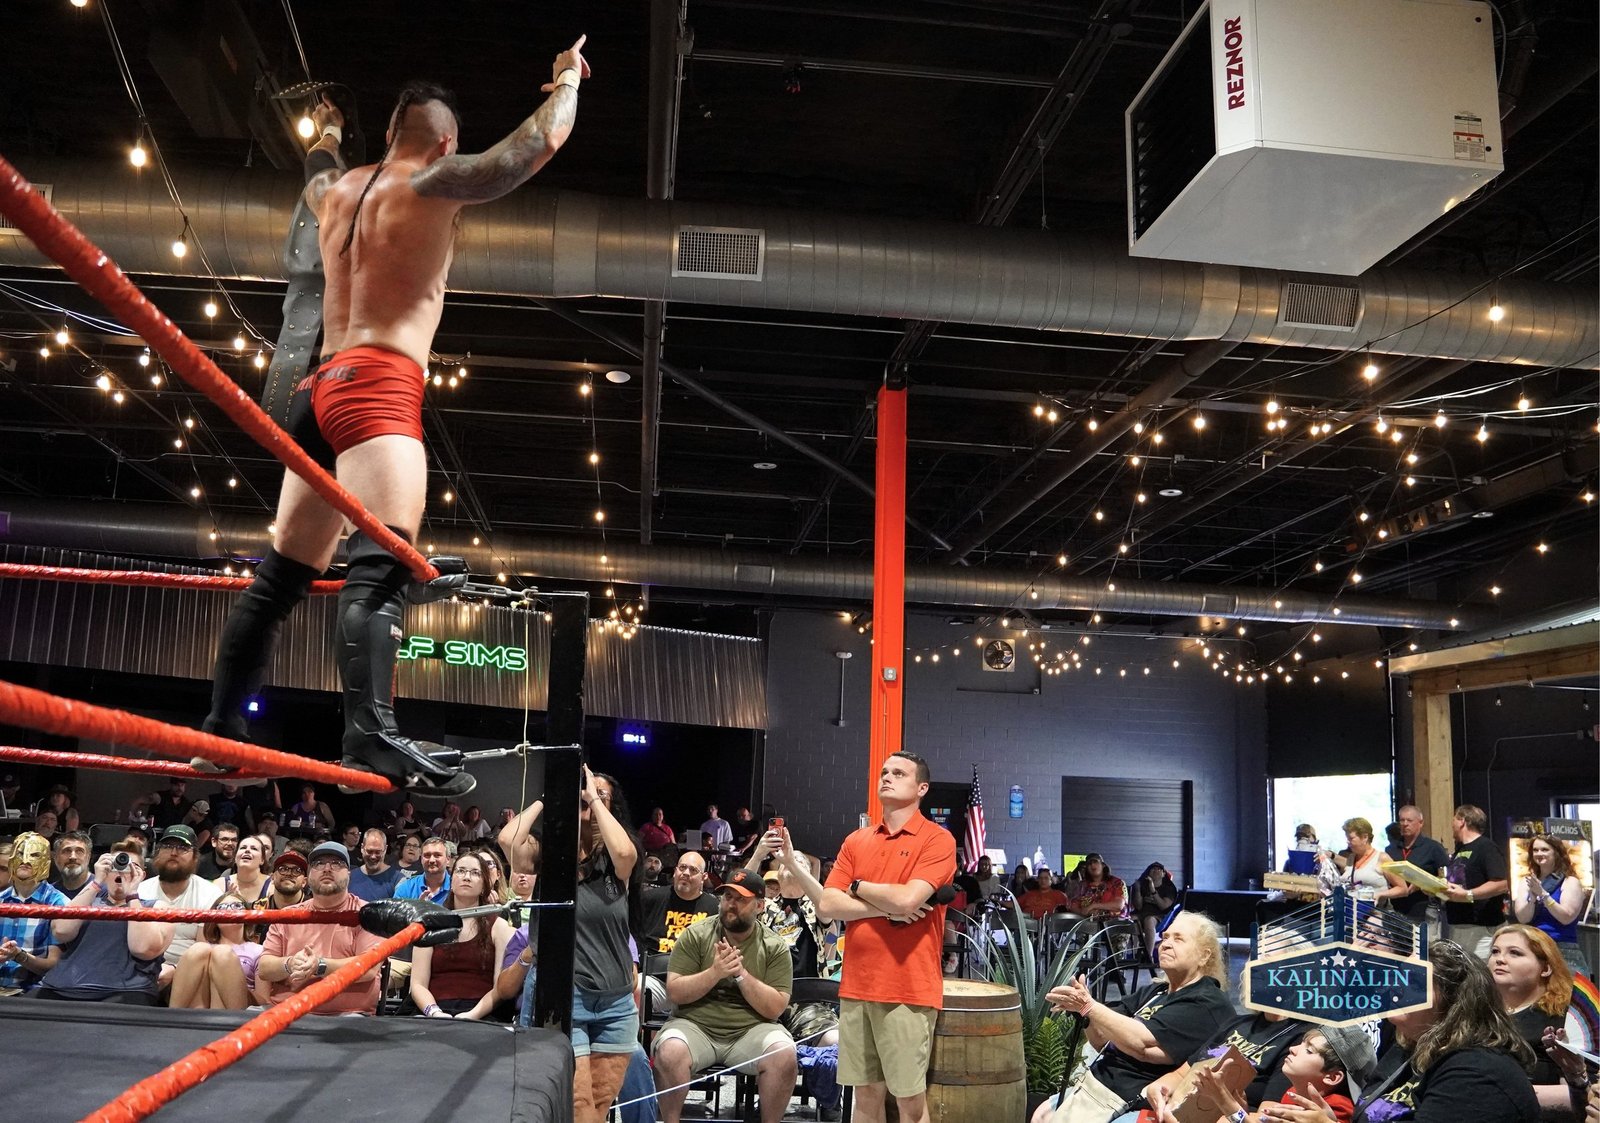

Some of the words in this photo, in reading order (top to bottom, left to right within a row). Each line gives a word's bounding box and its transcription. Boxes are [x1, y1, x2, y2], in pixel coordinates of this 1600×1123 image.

[1224, 15, 1245, 110] REZNOR
[444, 640, 527, 671] SIMS
[1550, 825, 1579, 835] NACHOS
